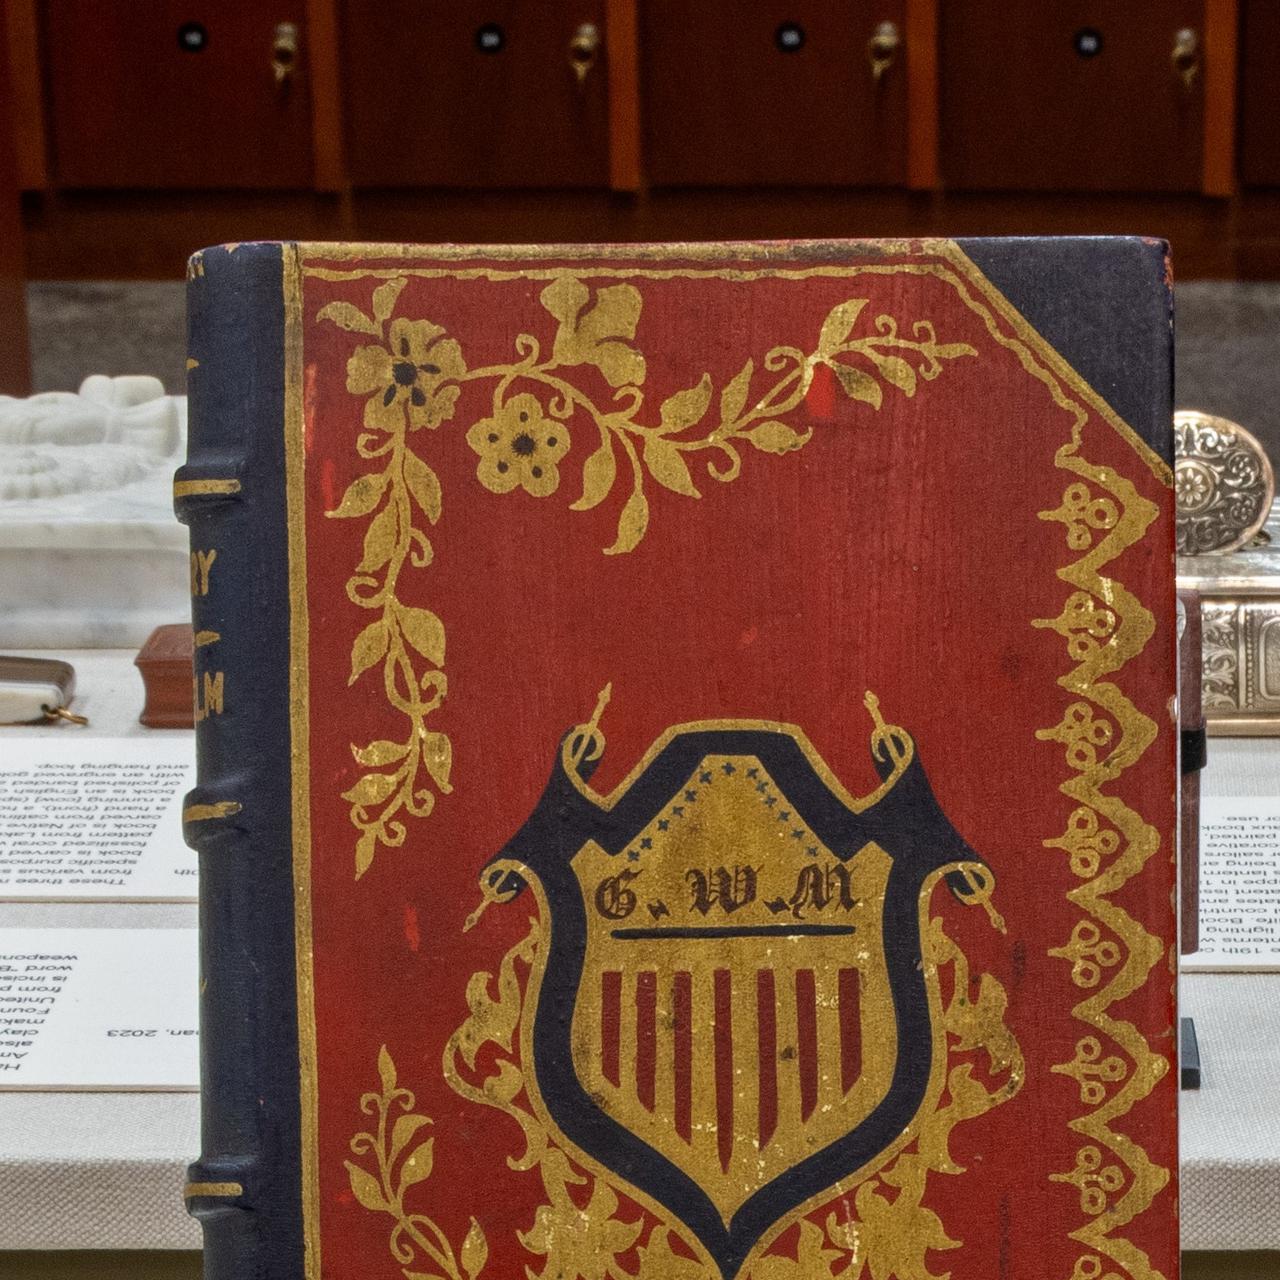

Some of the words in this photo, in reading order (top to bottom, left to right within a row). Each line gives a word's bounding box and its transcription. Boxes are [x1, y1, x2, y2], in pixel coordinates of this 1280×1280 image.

[24, 965, 73, 973] word
[17, 985, 62, 994] from
[106, 1029, 159, 1038] 2023
